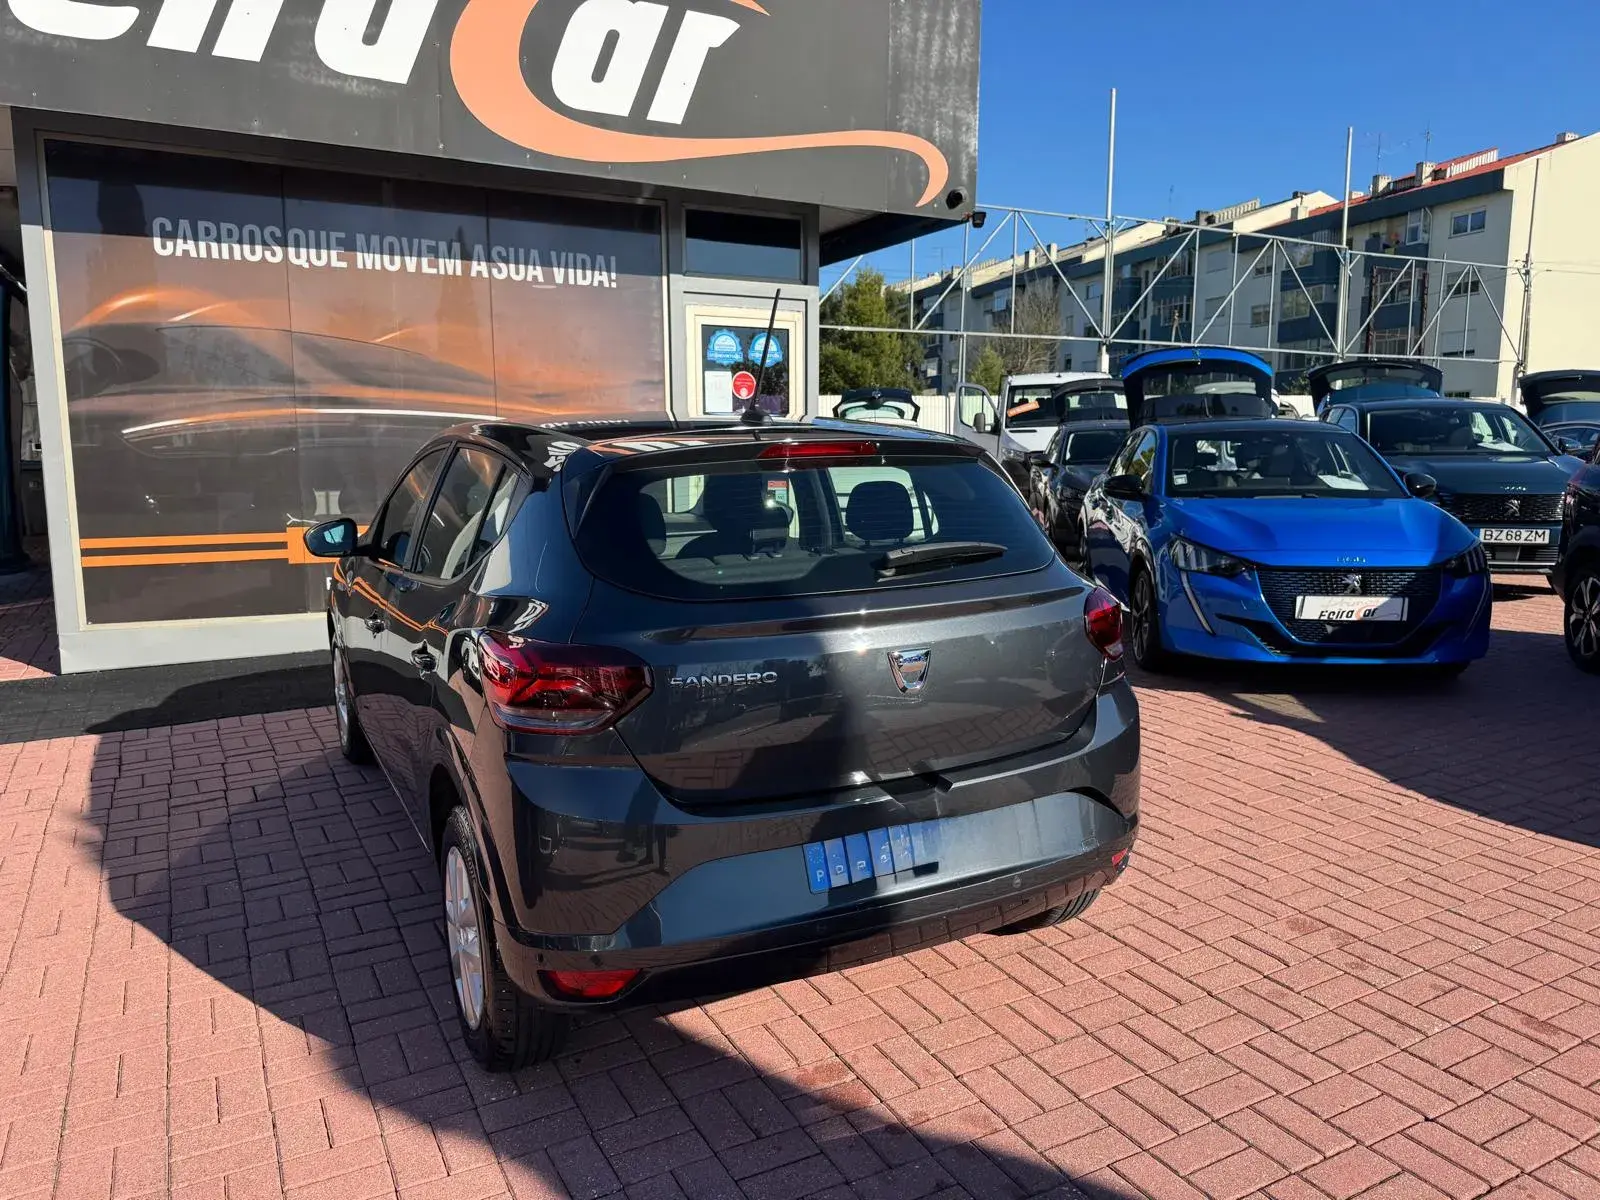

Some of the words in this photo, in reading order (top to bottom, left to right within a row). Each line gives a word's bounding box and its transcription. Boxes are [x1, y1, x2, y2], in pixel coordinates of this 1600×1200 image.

[152, 217, 283, 263] CARROS
[287, 228, 348, 268] QUE
[355, 232, 462, 277] MOVEM
[470, 244, 489, 278] A
[491, 245, 544, 283] SUA
[549, 250, 617, 288] VIDA!
[670, 671, 778, 688] SANDERO
